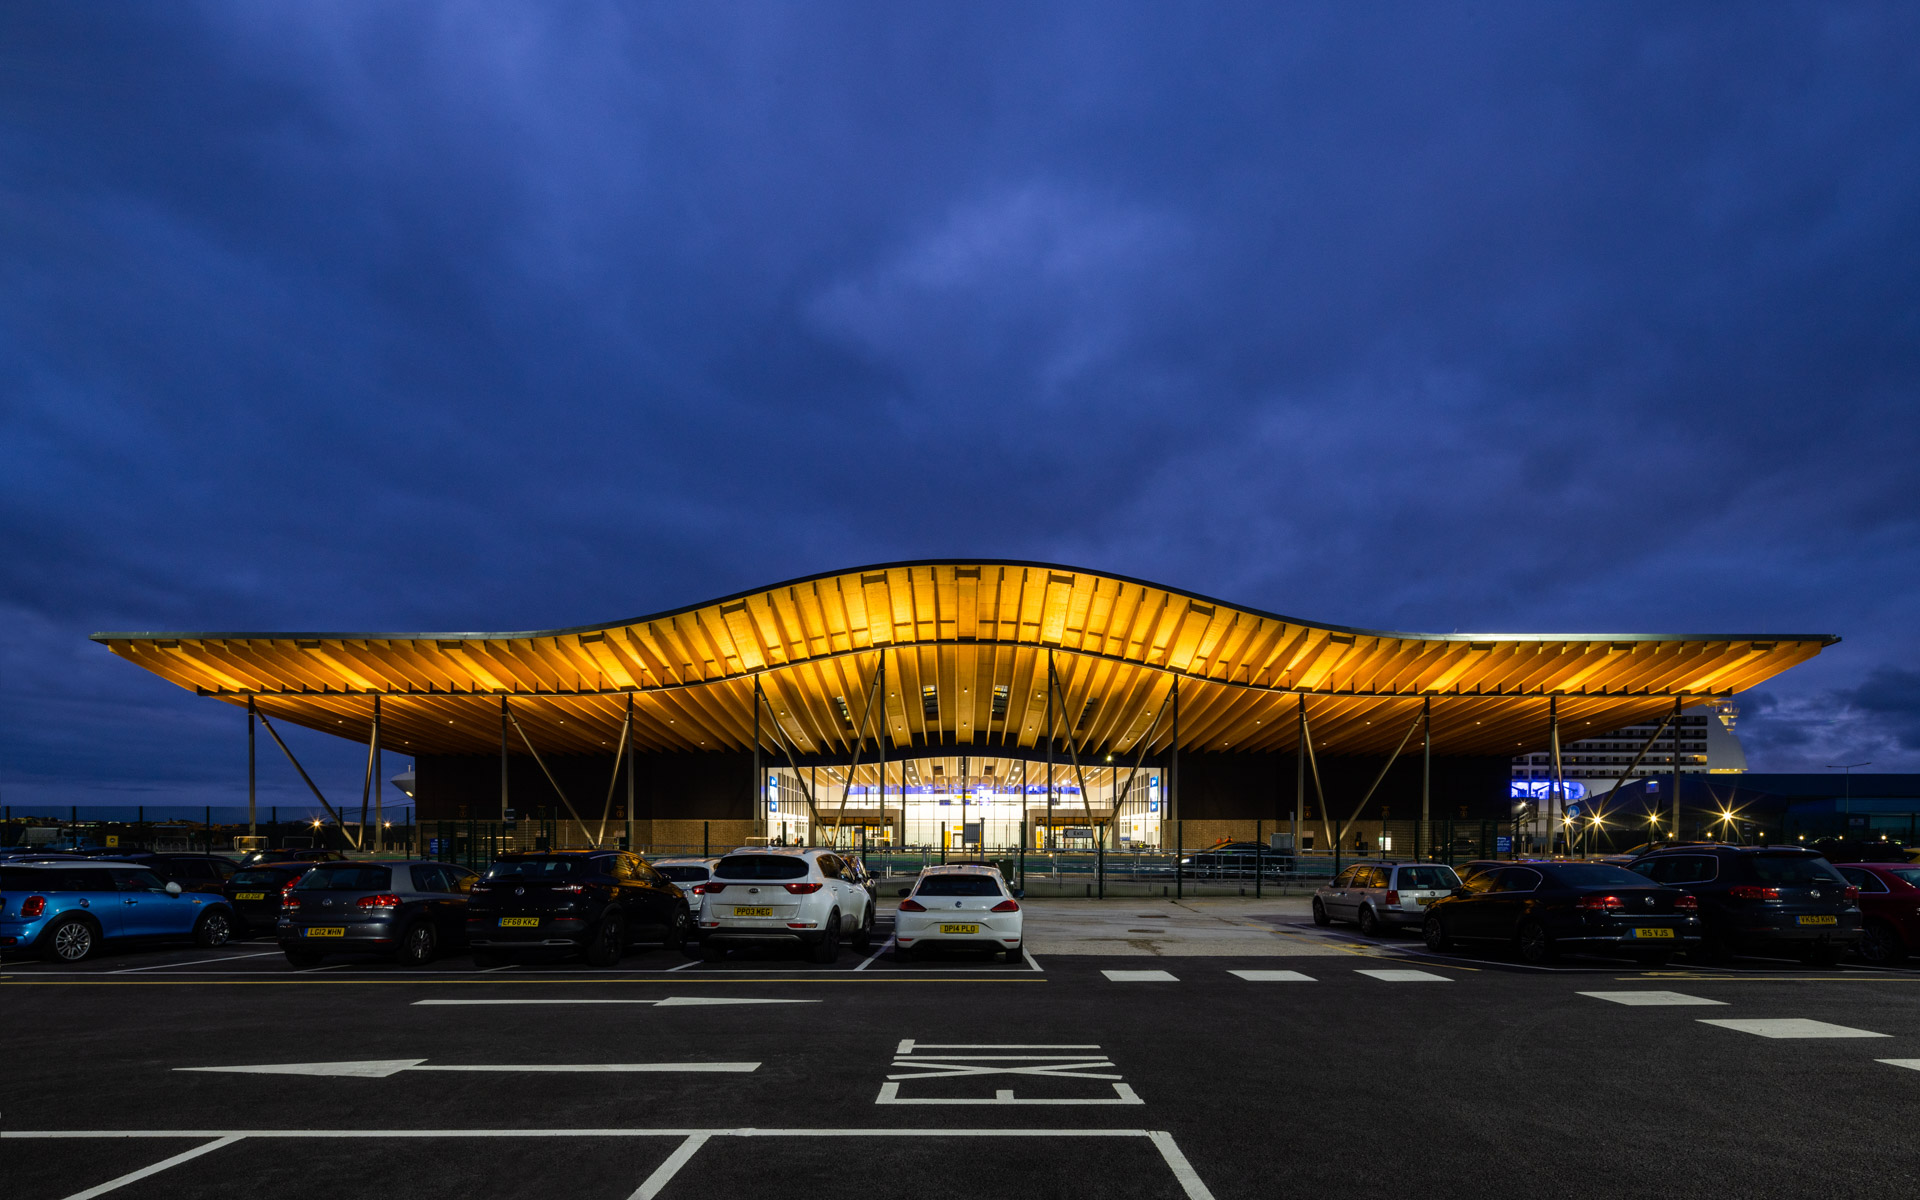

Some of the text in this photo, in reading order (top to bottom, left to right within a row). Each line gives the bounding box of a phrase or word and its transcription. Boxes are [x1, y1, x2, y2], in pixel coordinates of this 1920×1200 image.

[736, 907, 755, 915] PP03
[310, 928, 342, 936] LG12 WHN
[875, 1039, 1145, 1104] EXIT
